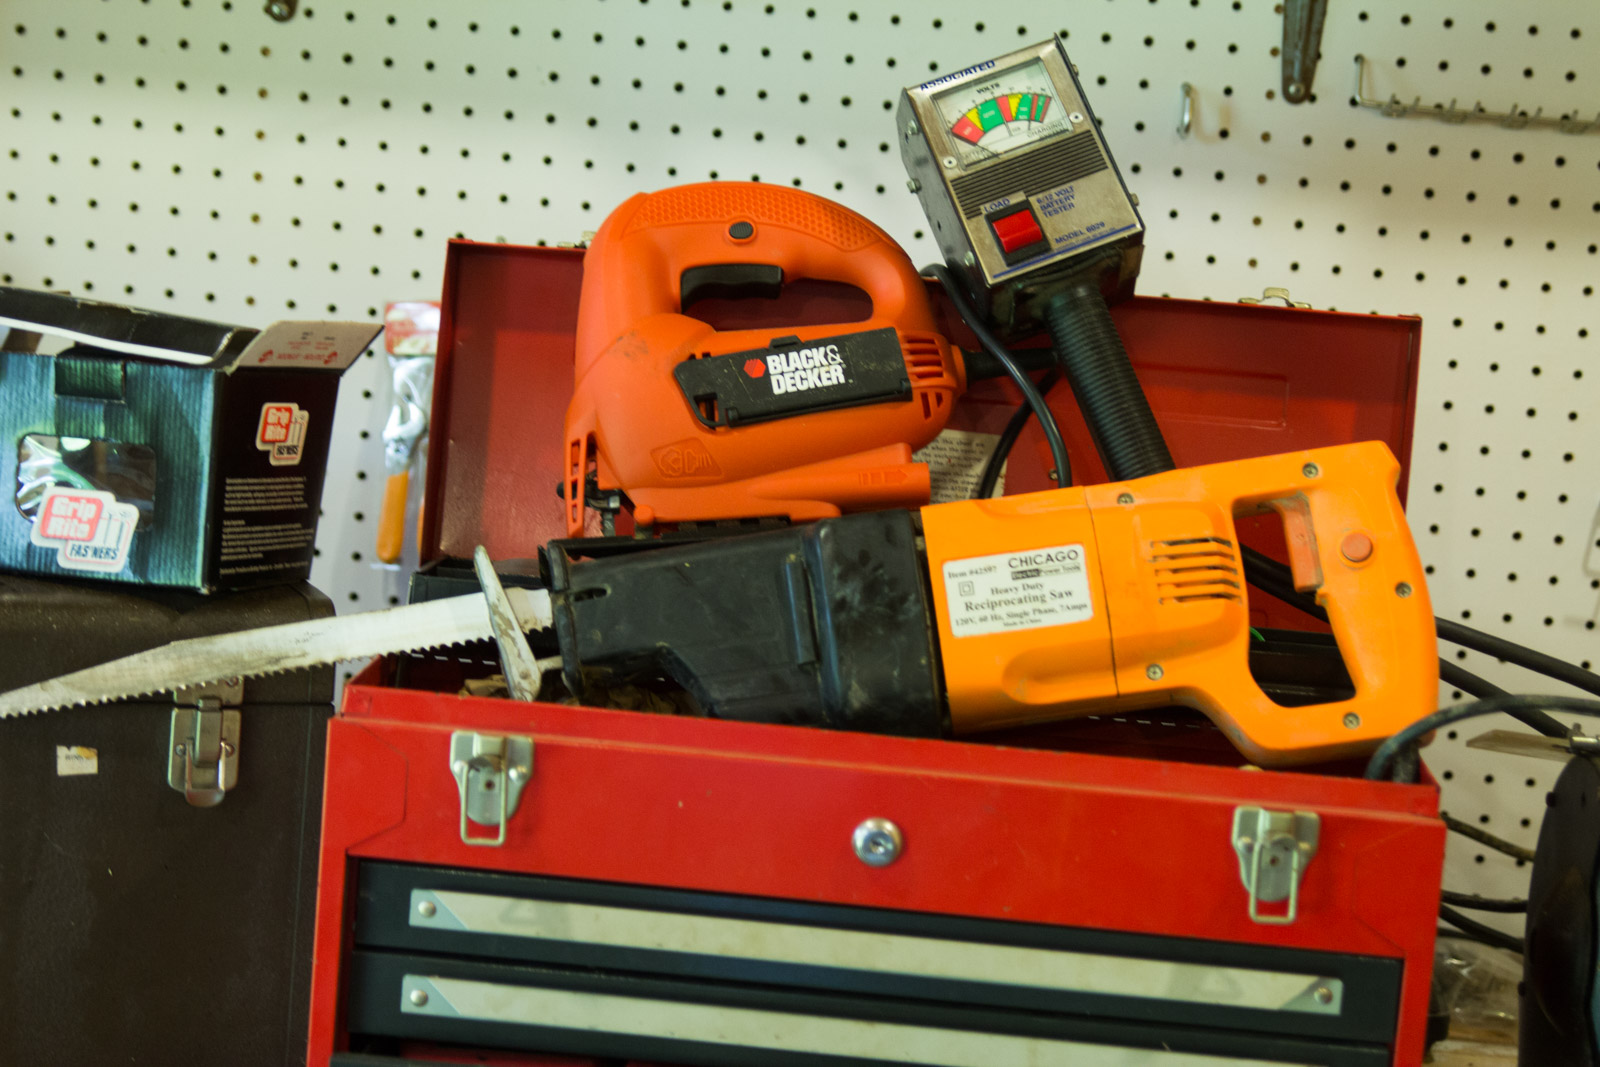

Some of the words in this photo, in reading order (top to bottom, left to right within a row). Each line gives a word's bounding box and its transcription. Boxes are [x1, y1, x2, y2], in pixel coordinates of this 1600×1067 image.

[919, 59, 996, 91] ASSOCIATED
[975, 82, 1000, 95] VOLTS
[1054, 185, 1075, 198] VOLT
[983, 198, 1011, 213] LOAD
[1040, 194, 1076, 212] BATTERY
[1043, 202, 1076, 219] TESTER
[1055, 229, 1084, 244] MODEL
[770, 364, 846, 395] DECKER
[51, 496, 97, 522] Grip
[46, 516, 91, 538] Rite
[1008, 549, 1079, 569] CHICAGO
[948, 570, 967, 580] Item
[991, 584, 1019, 596] Heavy
[1022, 582, 1044, 593] Duty
[964, 592, 1048, 612] Reciprocating
[1050, 589, 1074, 601] Saw
[1006, 610, 1030, 621] Single
